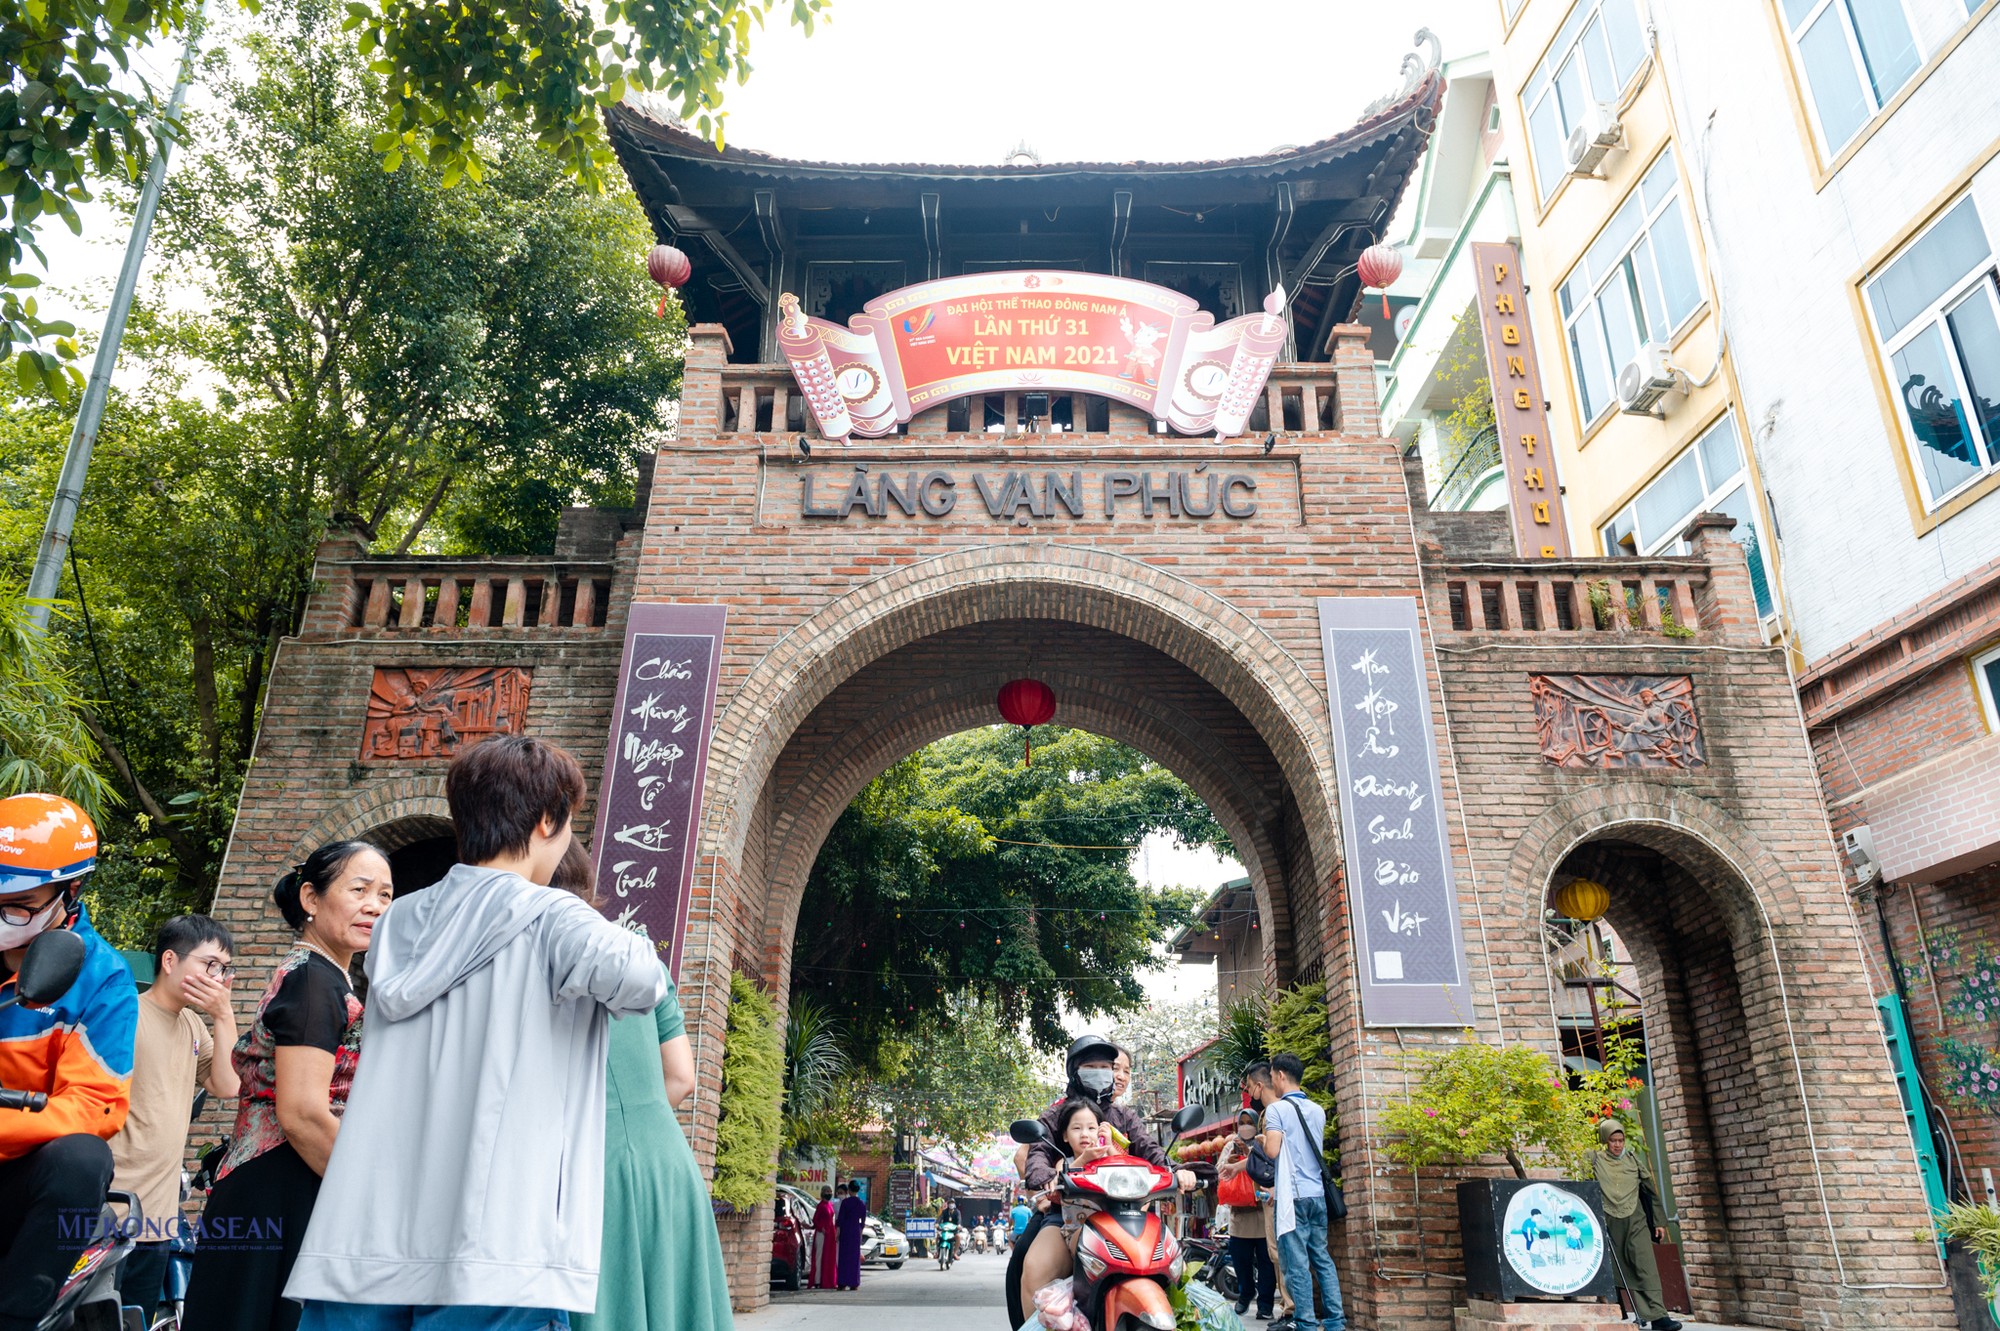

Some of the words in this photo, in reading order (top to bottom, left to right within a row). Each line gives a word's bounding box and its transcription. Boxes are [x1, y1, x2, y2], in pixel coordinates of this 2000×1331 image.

[947, 301, 968, 316] ĐẠI
[971, 298, 993, 313] HỘI
[996, 296, 1019, 310] THỂ
[1022, 299, 1052, 310] THAO
[1054, 298, 1088, 313] ĐÔNG
[1091, 304, 1117, 315] NAM
[1119, 304, 1127, 317] Á
[974, 315, 1012, 336] LẦN
[1018, 314, 1062, 336] THỨ
[1065, 319, 1089, 336] 31
[1493, 263, 1531, 410] PHONG
[946, 341, 999, 370] VIỆT
[1006, 346, 1056, 365] NAM
[1064, 346, 1118, 365] 2021
[801, 463, 957, 518] LÀNG
[972, 471, 1084, 527] VẠN
[1104, 461, 1258, 518] PHÚC
[624, 732, 684, 783] Nghiệp
[1357, 726, 1400, 759] Âm
[613, 819, 673, 852] Kết
[1367, 814, 1415, 845] Sinh
[612, 860, 658, 897] Tinh
[1374, 857, 1421, 889] Bảo
[1382, 898, 1430, 937] Vật
